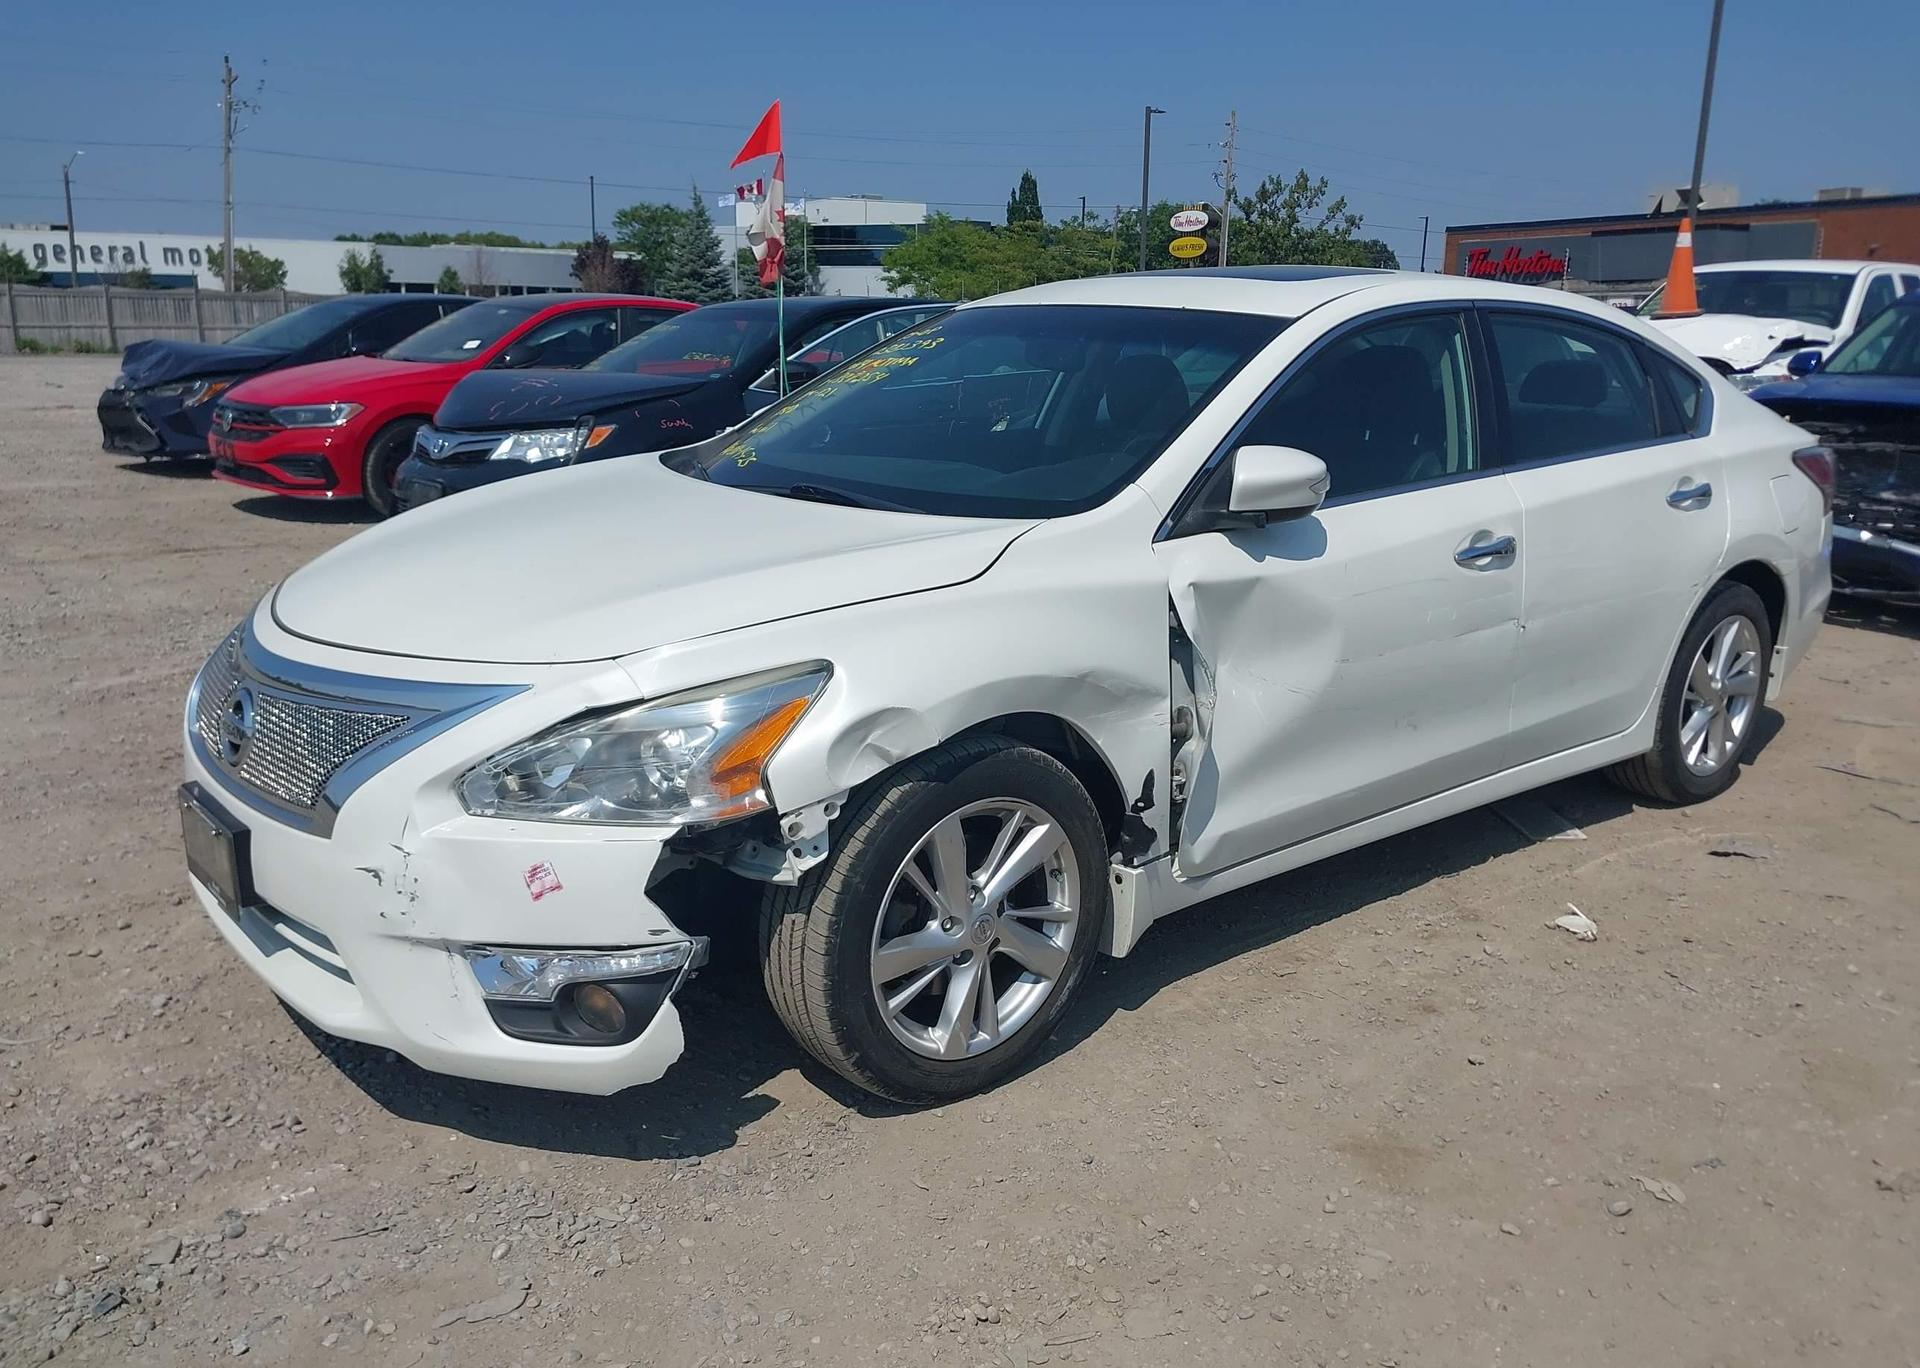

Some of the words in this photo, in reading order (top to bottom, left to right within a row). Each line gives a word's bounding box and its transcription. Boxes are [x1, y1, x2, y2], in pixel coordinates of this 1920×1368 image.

[1173, 216, 1184, 227] Tim
[1184, 215, 1205, 227] Hortons
[33, 240, 149, 269] general
[1467, 247, 1499, 276] Tim
